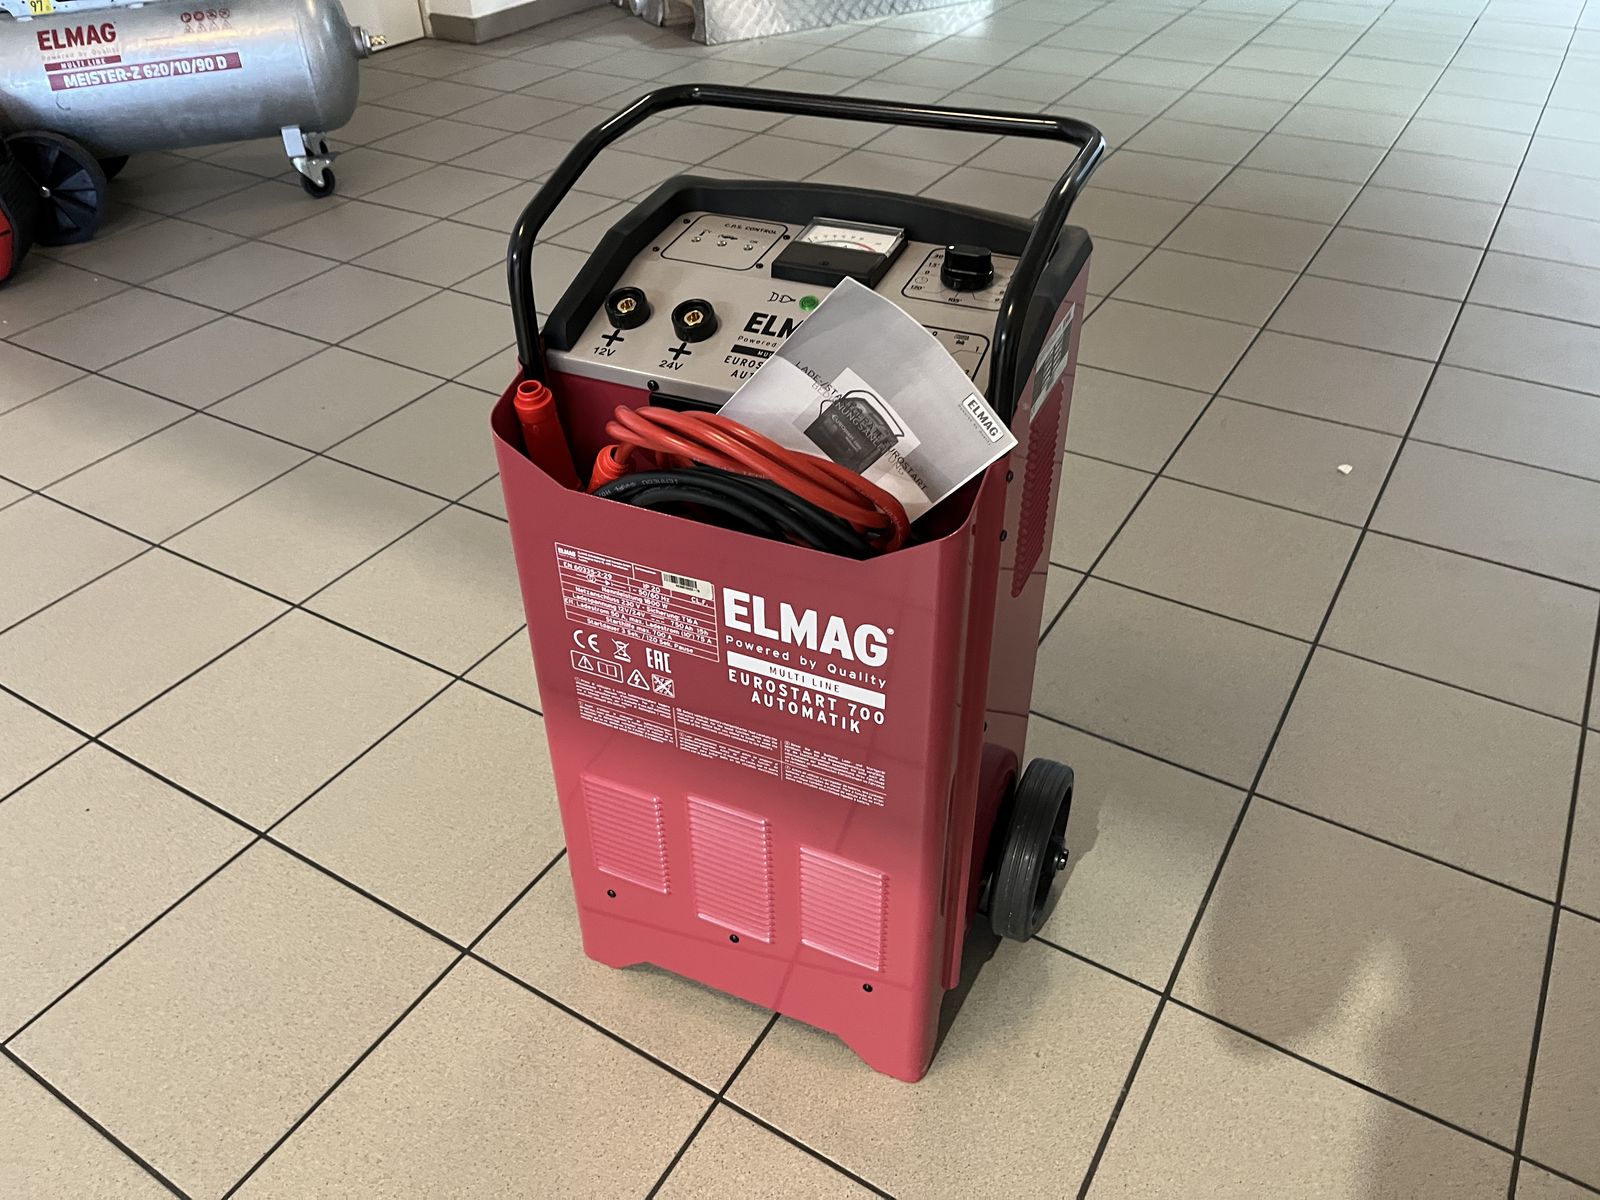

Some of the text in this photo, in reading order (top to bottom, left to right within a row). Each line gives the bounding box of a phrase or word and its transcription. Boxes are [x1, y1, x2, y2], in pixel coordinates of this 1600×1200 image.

[37, 22, 116, 51] ELMAG
[60, 58, 106, 69] MULTI LINE
[63, 55, 228, 88] MEISTER-Z 620/10/90 D
[745, 225, 777, 235] CONTROL
[593, 346, 616, 357] 12V
[737, 335, 778, 348] Powered
[659, 359, 684, 371] 24V
[724, 355, 764, 370] EUROS
[967, 399, 999, 437] ELMAG
[652, 630, 666, 638] 700
[722, 587, 888, 668] ELMAG
[573, 629, 600, 654] CE
[645, 647, 672, 674] EAC
[725, 634, 887, 689] Powered by Quality
[769, 665, 840, 694] MULTI LINE
[728, 668, 885, 725] EUROSTART 700
[751, 690, 861, 734] AUTOMATIK
